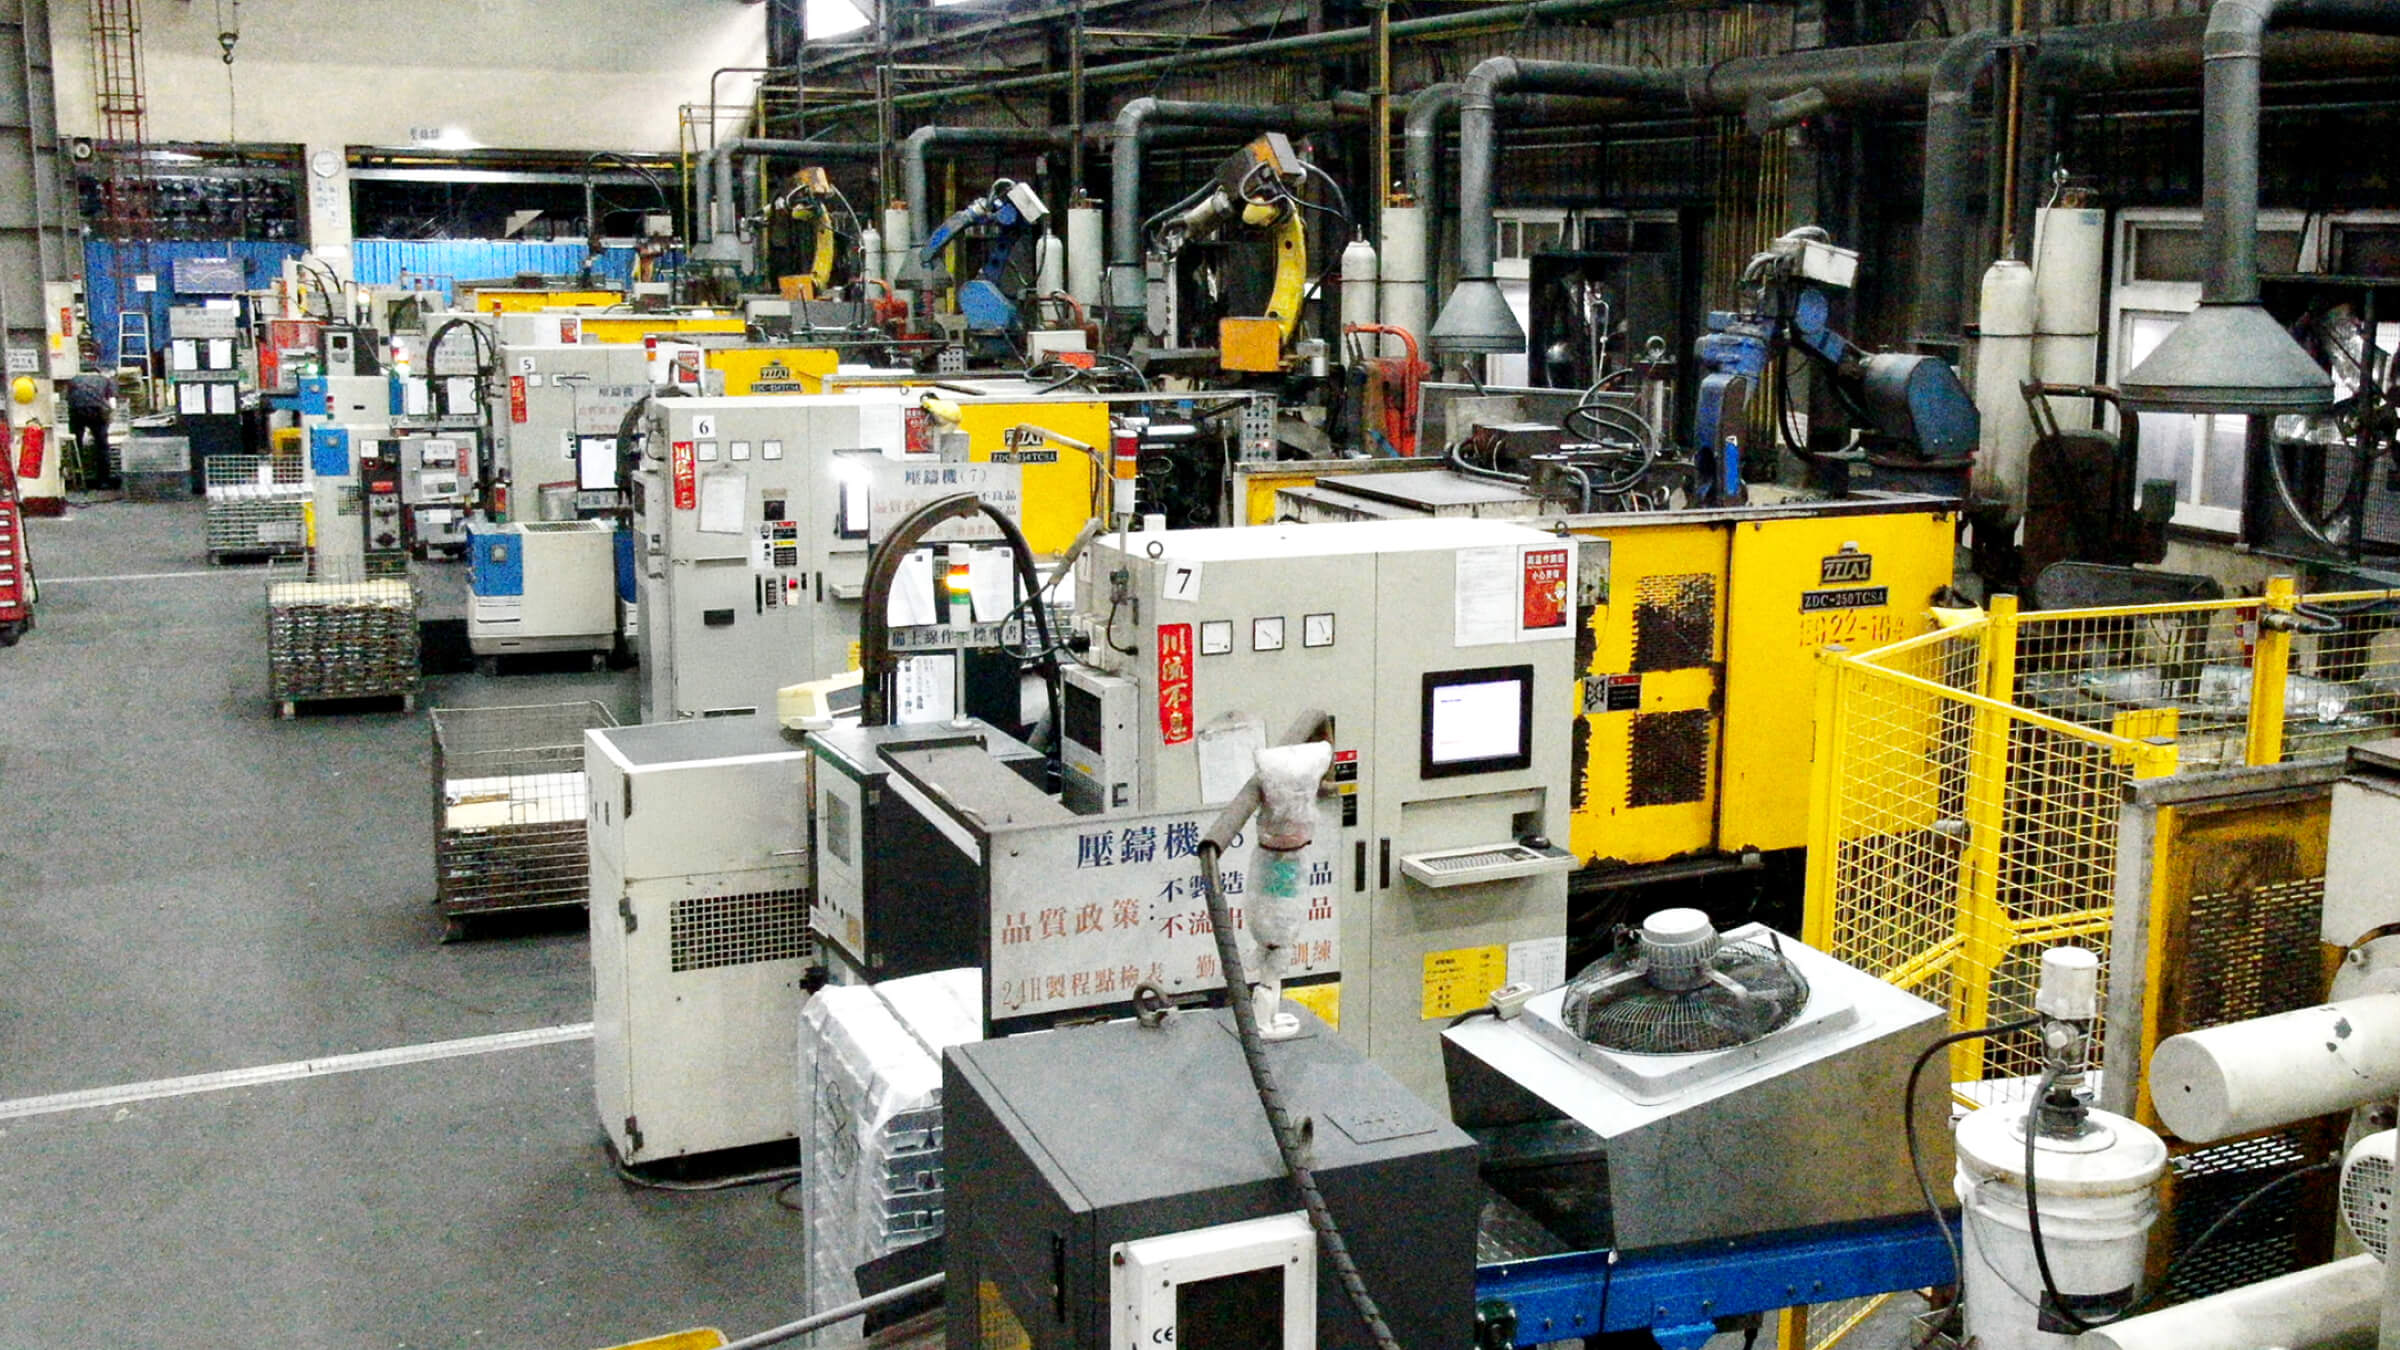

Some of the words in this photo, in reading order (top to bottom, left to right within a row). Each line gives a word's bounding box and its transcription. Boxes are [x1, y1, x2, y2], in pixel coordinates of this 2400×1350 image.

[523, 359, 532, 371] 5
[699, 420, 709, 434] 6
[1177, 568, 1192, 594] 7
[1162, 627, 1188, 741] 川流不息
[1077, 821, 1244, 870] 壓鑄機
[1158, 861, 1333, 904] 不製造品
[1158, 896, 1333, 939] 不流出品
[1196, 940, 1333, 979] 勤訓練
